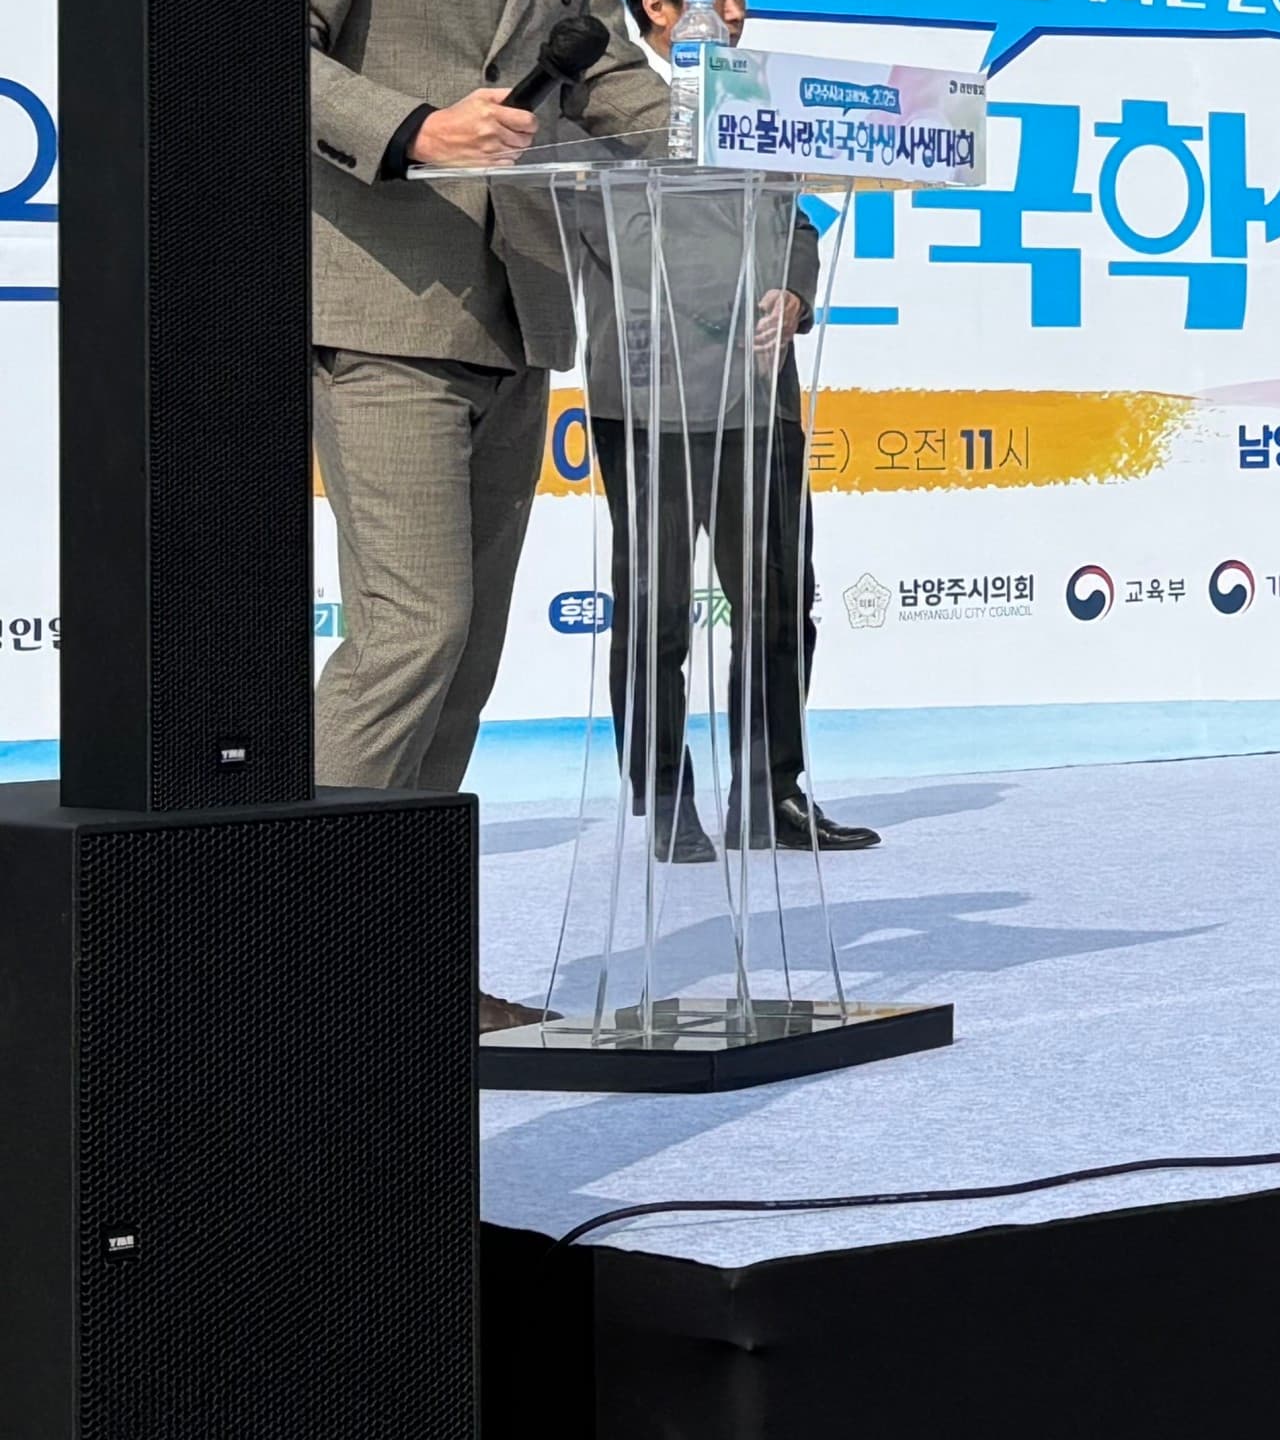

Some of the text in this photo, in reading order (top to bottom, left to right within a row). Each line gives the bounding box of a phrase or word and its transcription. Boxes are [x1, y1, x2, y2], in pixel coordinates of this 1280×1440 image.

[873, 427, 948, 472] 오전
[959, 427, 1031, 470] 11시
[899, 573, 1034, 608] 남양주시의회
[1124, 577, 1186, 604] 교육부
[559, 596, 605, 627] 후원
[898, 604, 1033, 622] NAMYANGJU CITY COUNCIL
